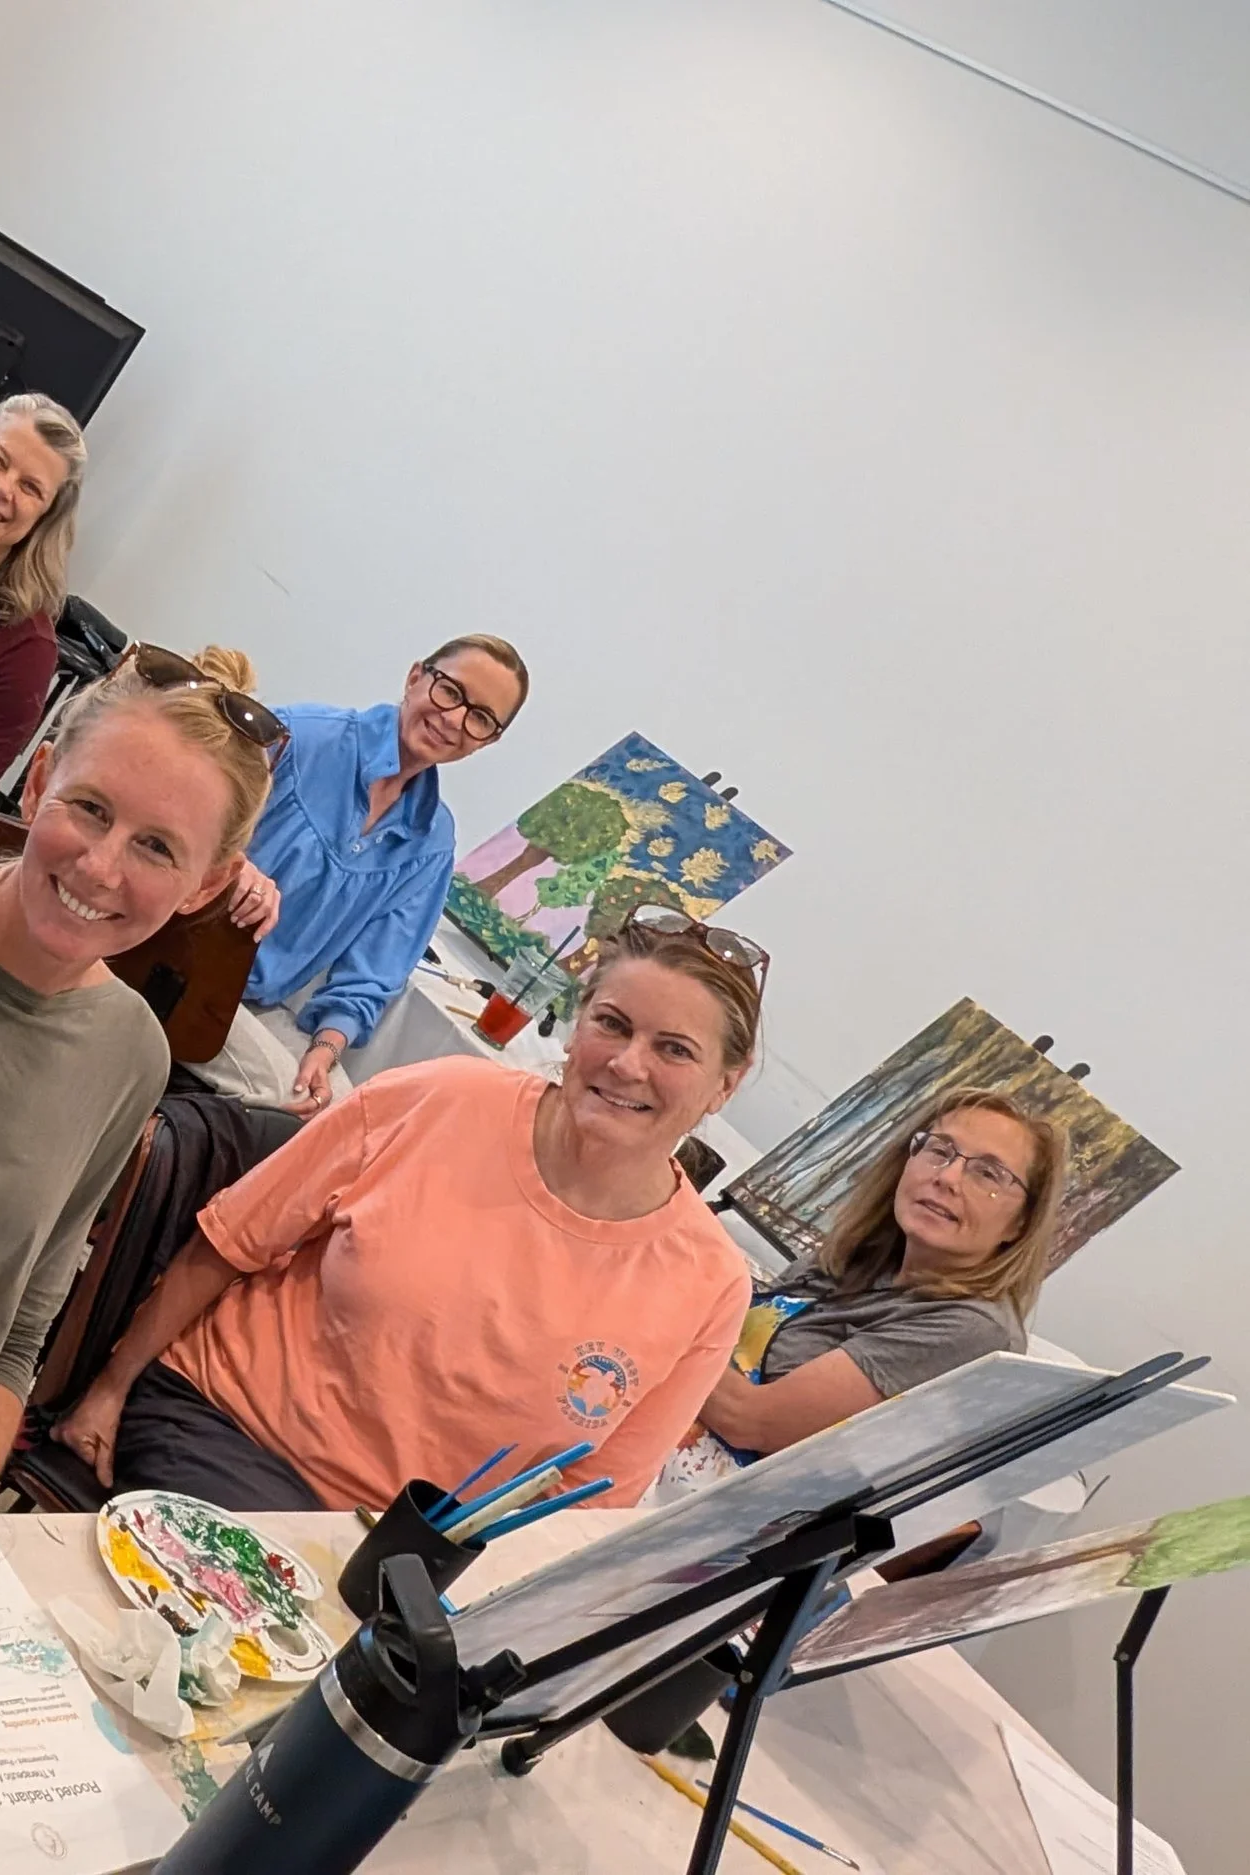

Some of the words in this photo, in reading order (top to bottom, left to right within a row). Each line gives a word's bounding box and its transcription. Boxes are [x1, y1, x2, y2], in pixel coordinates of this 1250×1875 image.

[574, 1341, 605, 1358] KEY
[612, 1346, 639, 1387] WEST
[556, 1395, 608, 1429] FLORIDA
[2, 1788, 54, 1805] Radiant,
[53, 1780, 101, 1800] Rooted,
[250, 1782, 282, 1825] CAMP
